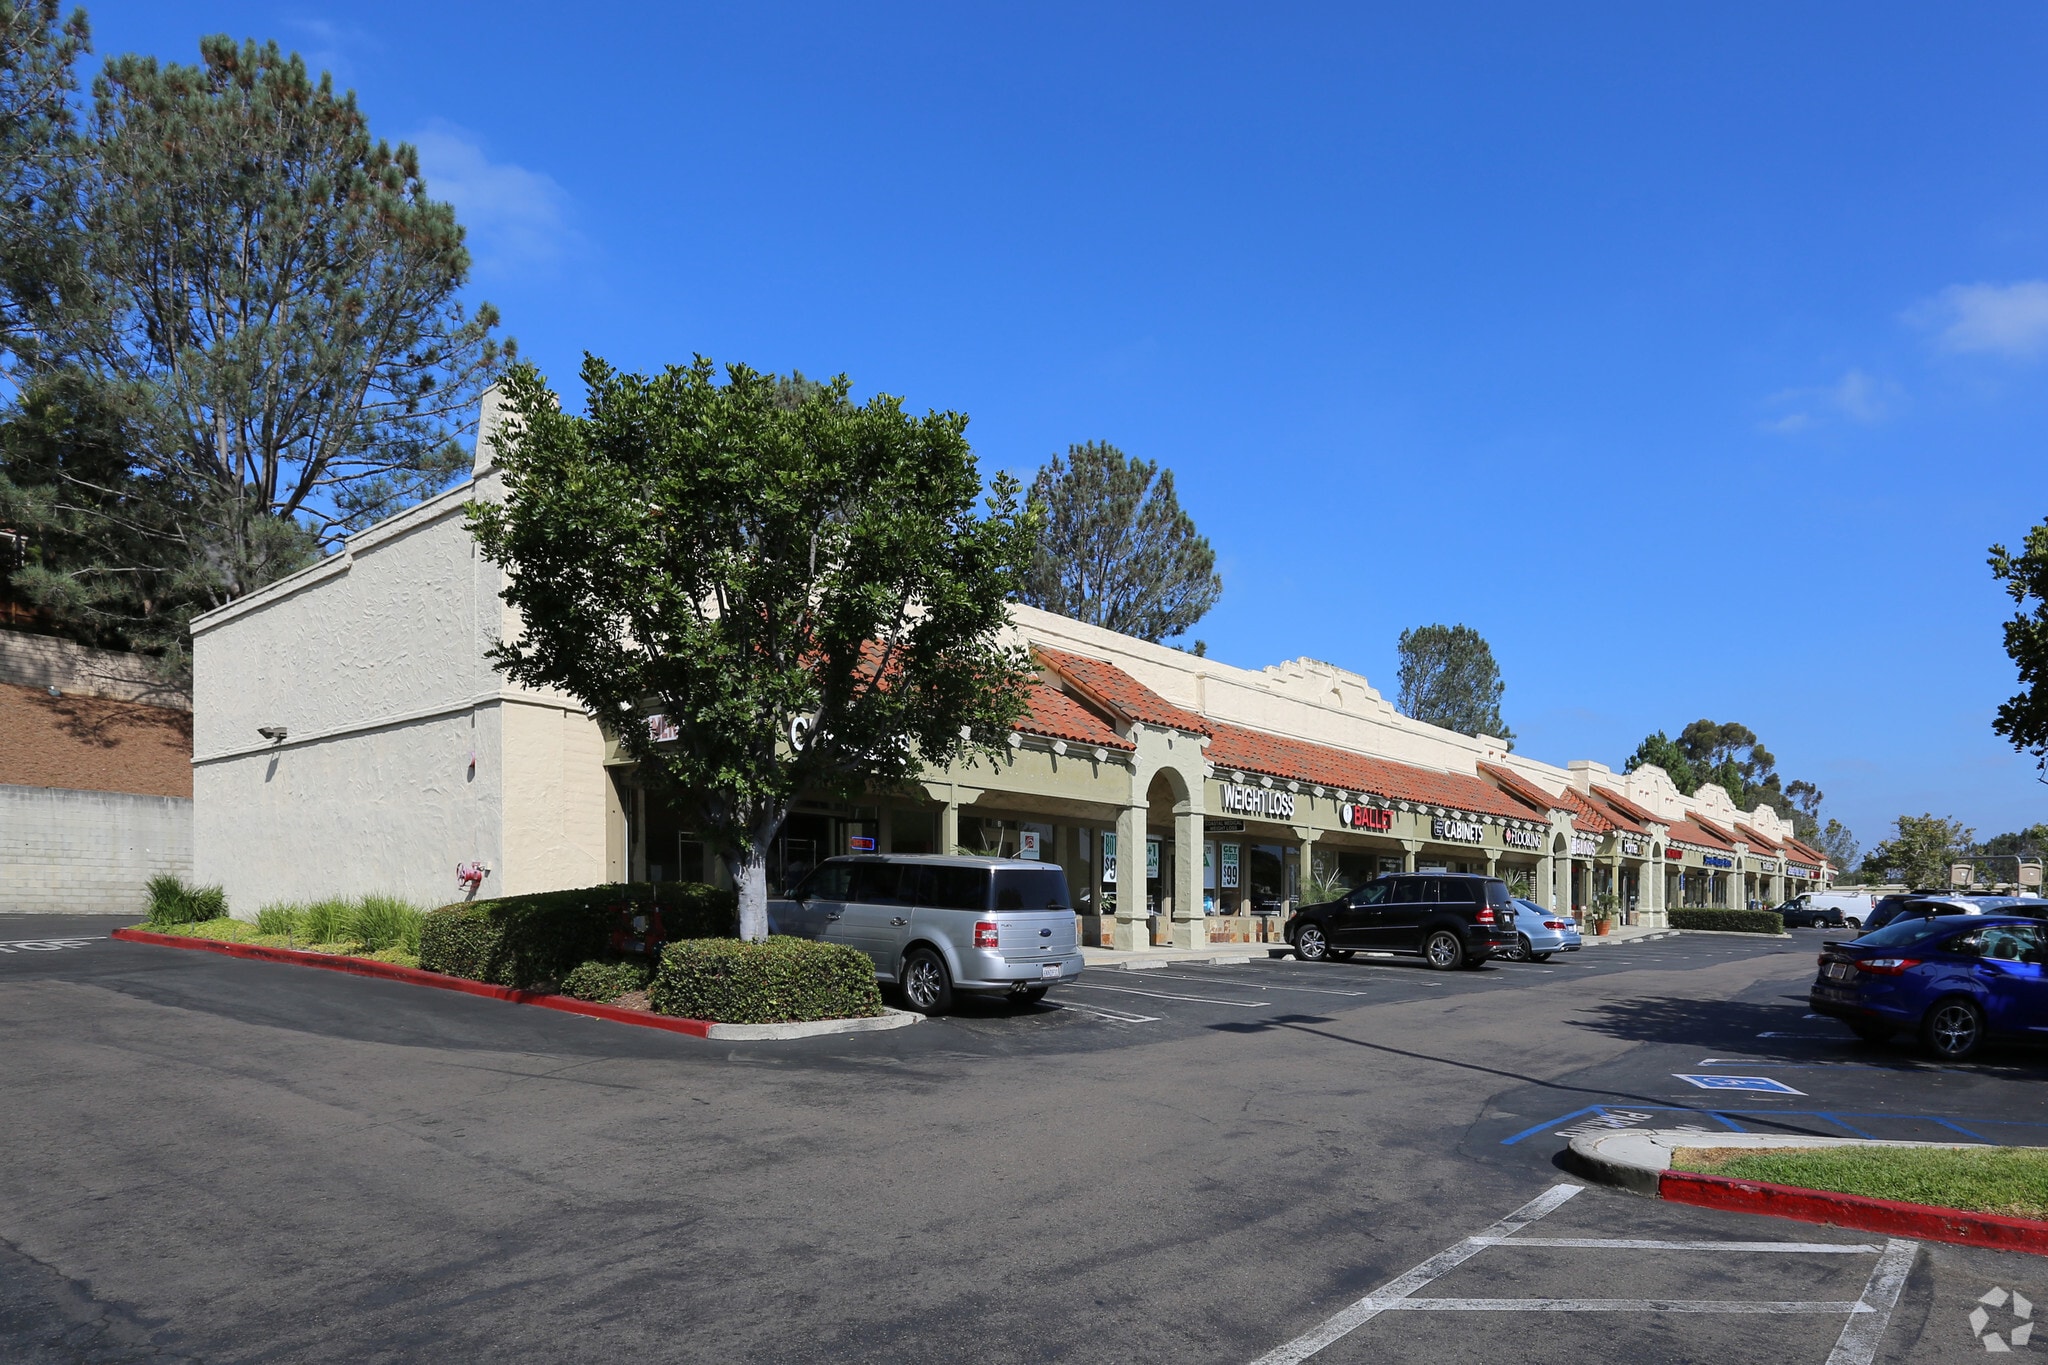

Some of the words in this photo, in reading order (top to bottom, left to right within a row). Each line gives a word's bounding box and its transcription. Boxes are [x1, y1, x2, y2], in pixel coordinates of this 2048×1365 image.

[1224, 784, 1267, 813] WEIGHT
[1268, 791, 1295, 817] LOSS
[1354, 805, 1394, 829] BALLET
[1444, 820, 1483, 842] CABINETS
[1511, 829, 1541, 848] FLOORING
[1223, 845, 1238, 853] GET
[1576, 839, 1596, 857] BLINDS
[1223, 865, 1238, 885] $99
